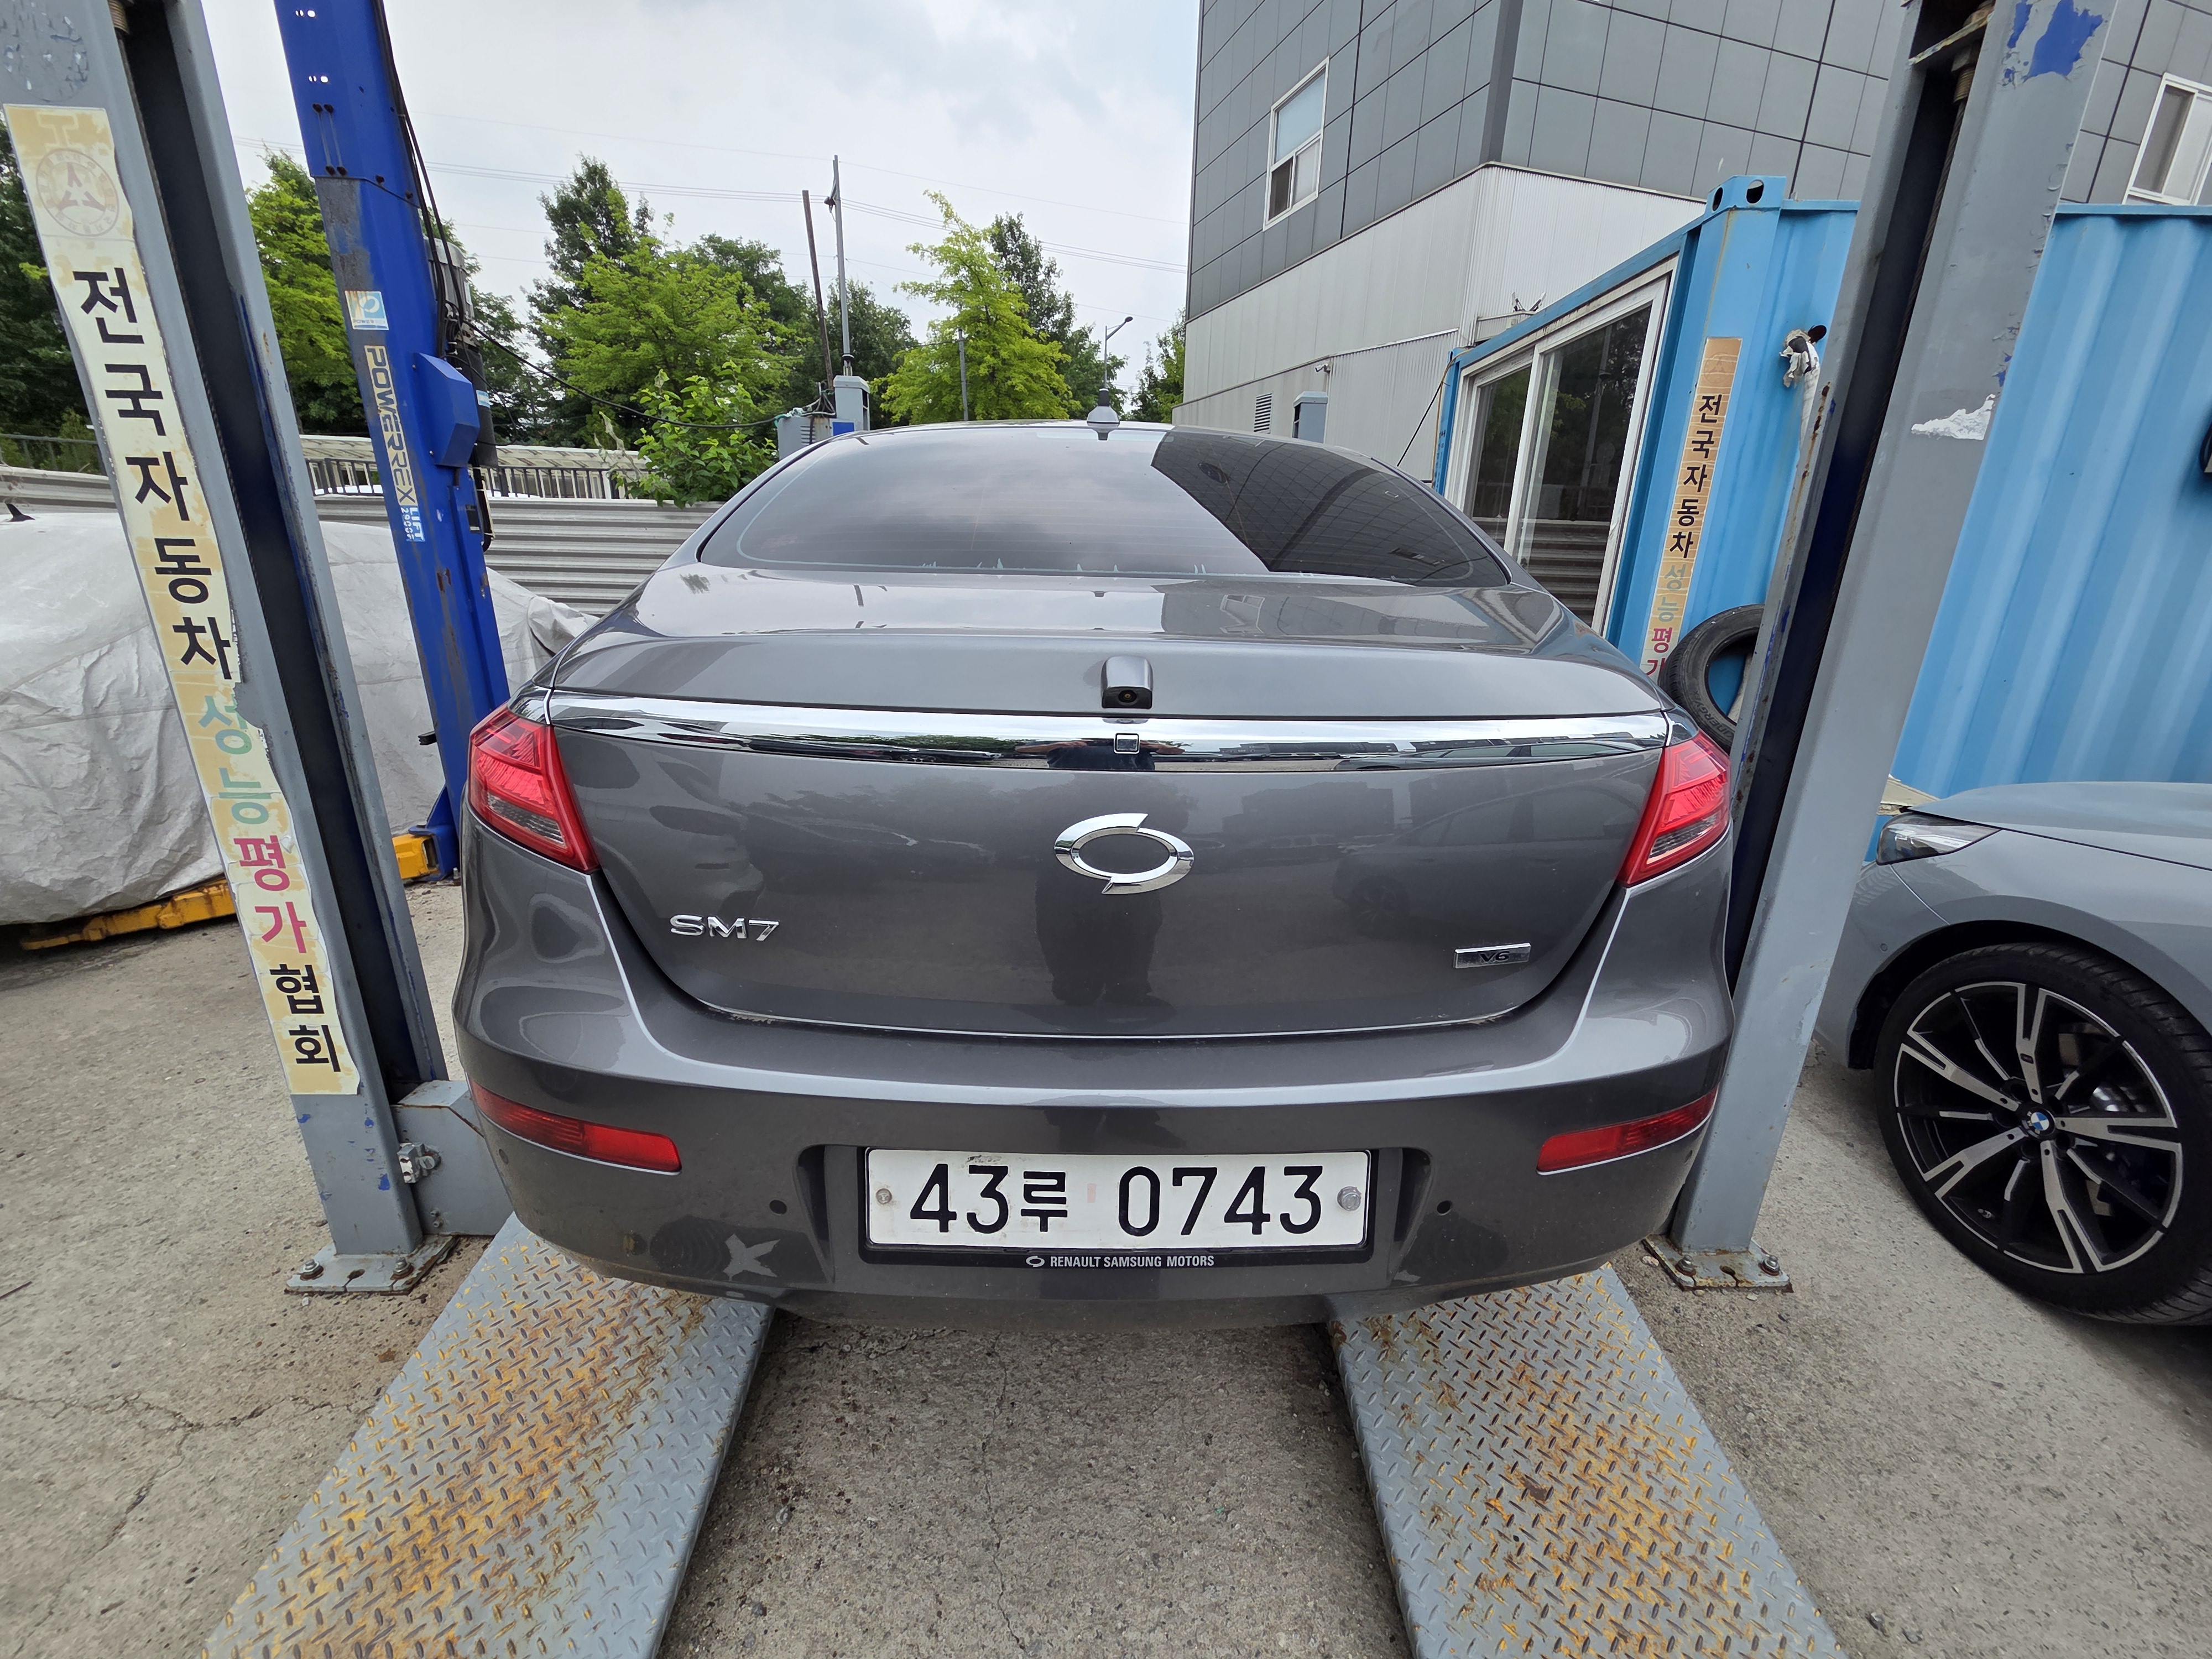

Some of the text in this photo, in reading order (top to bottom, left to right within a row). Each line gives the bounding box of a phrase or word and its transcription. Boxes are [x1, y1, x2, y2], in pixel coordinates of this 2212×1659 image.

[367, 347, 416, 503] POWERREX
[409, 507, 424, 540] LIFT
[670, 914, 779, 941] SM7
[1480, 950, 1510, 963] V6
[909, 1162, 1324, 1237] 43루 0743
[1050, 1255, 1215, 1267] RENAULT SAMSUNG MOTORS
